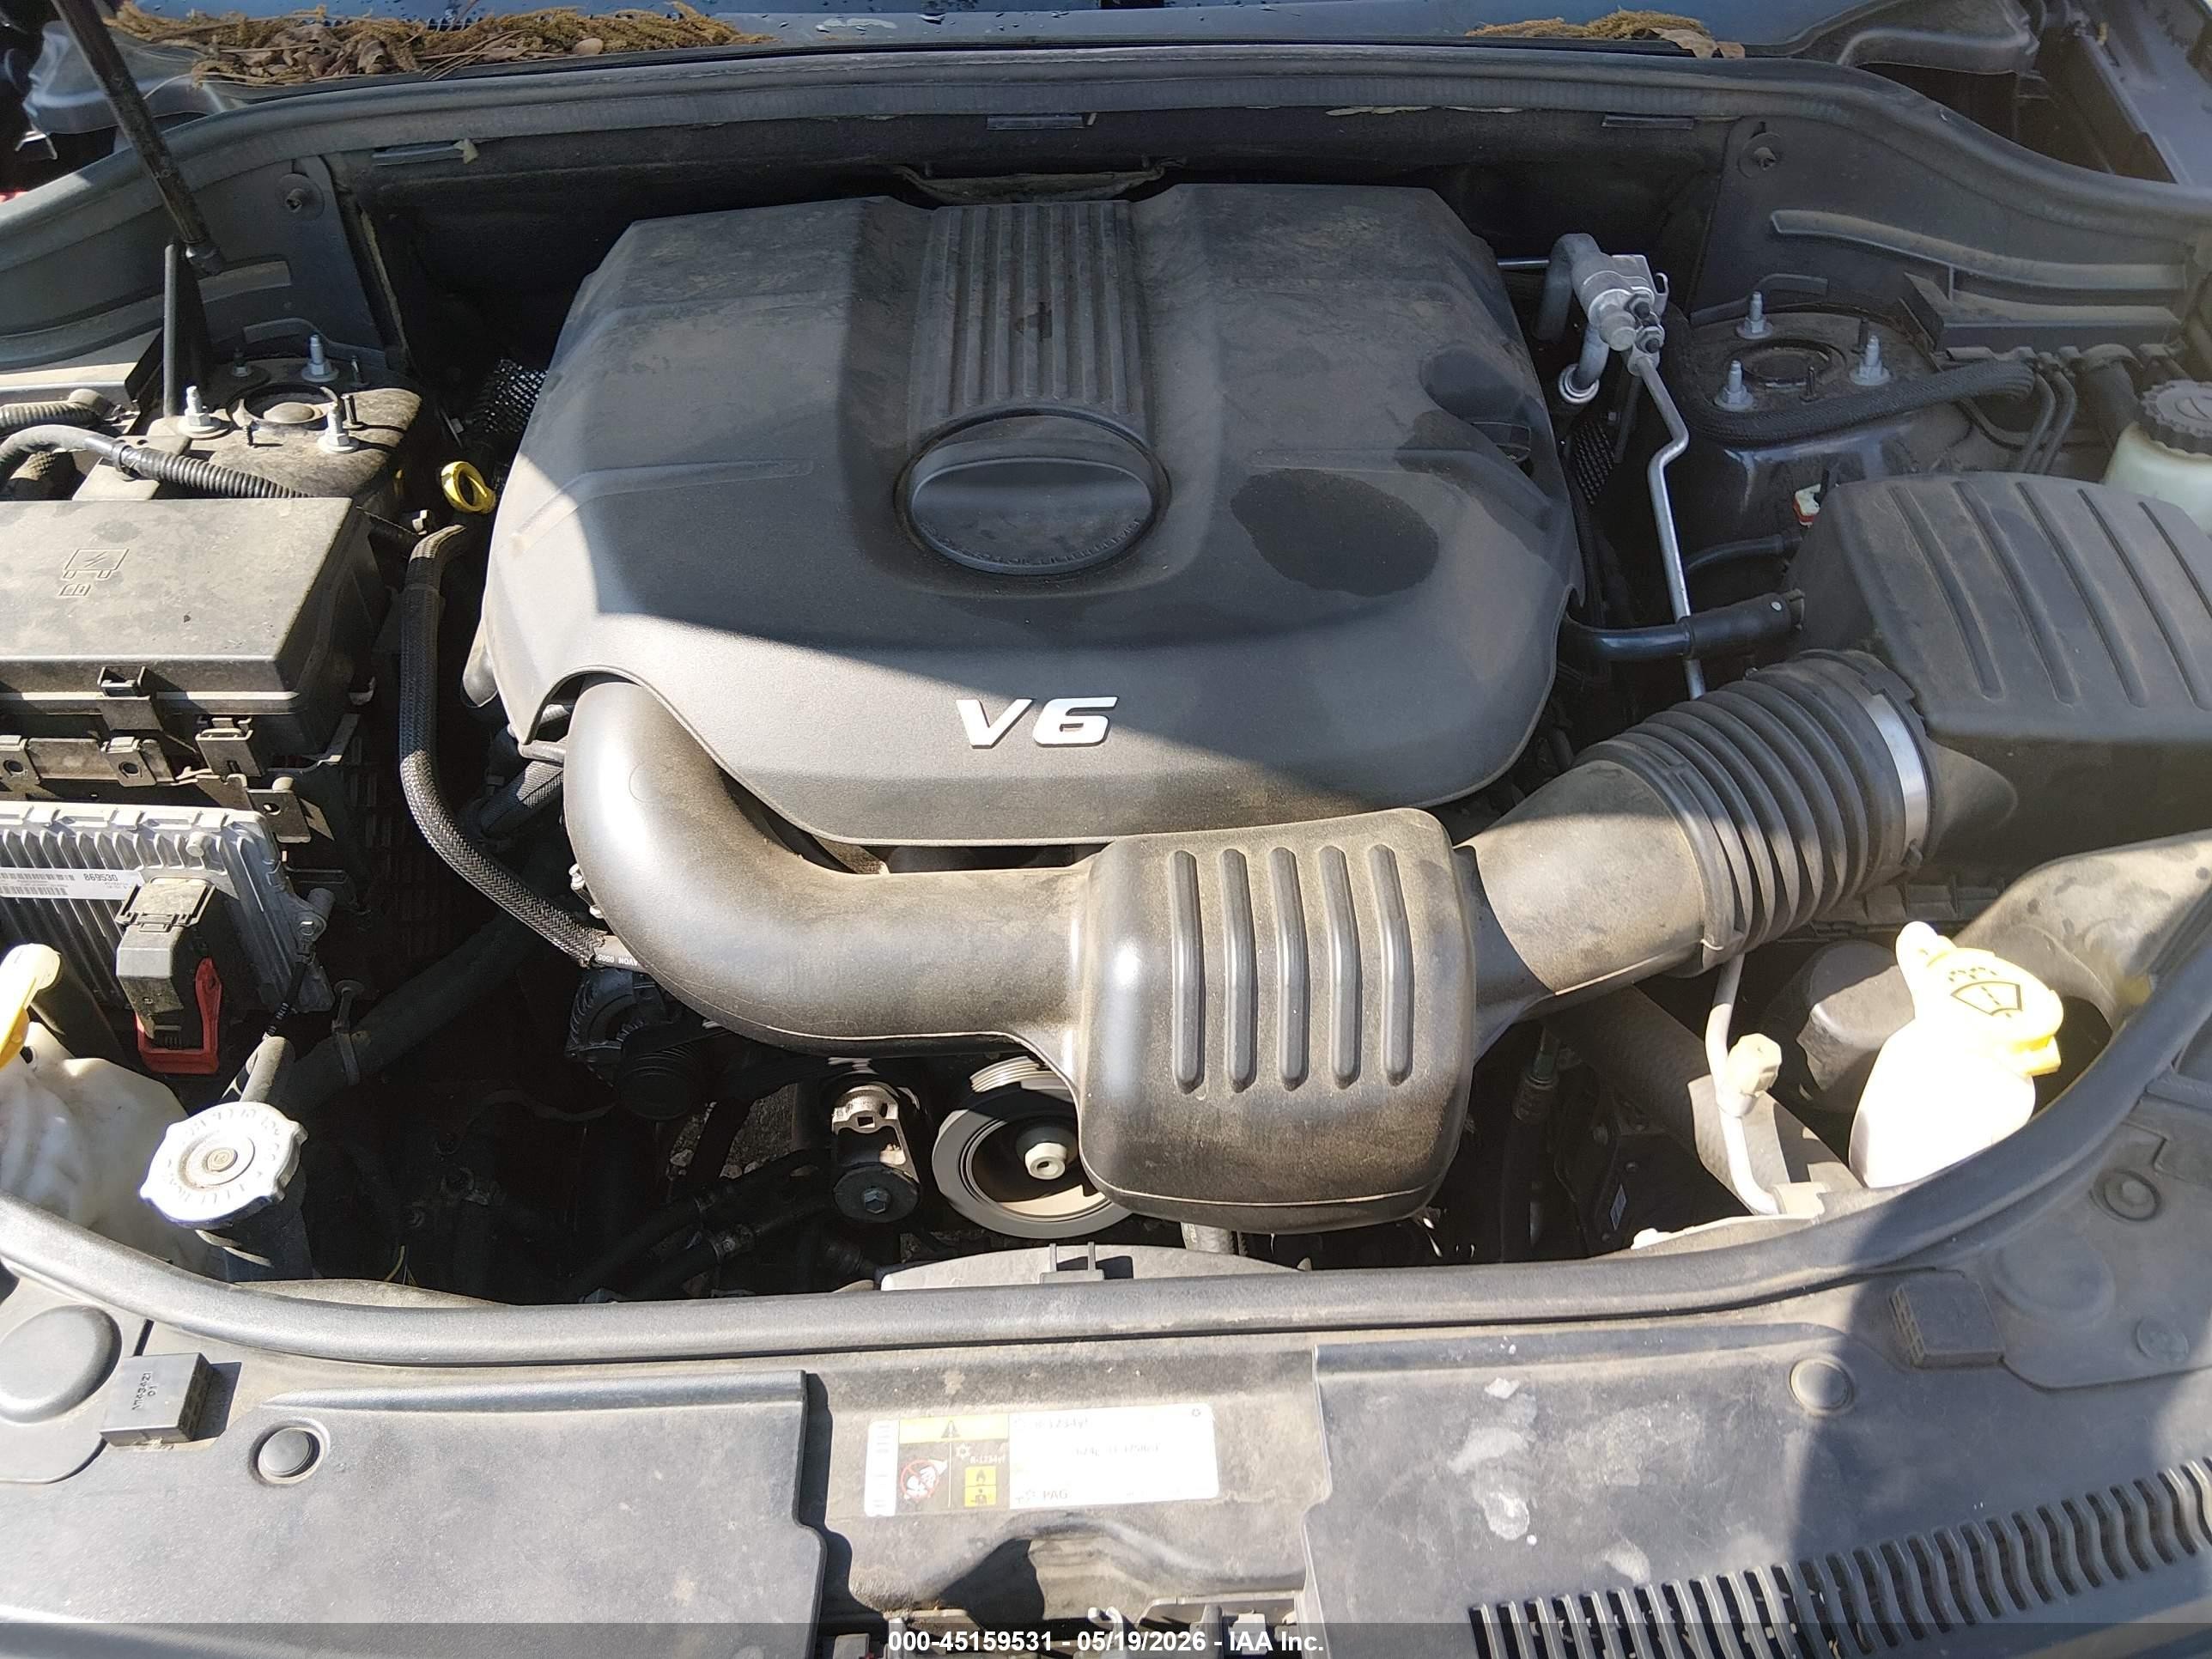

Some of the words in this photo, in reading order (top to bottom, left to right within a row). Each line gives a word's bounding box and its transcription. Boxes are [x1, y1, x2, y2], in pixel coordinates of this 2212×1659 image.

[956, 696, 1119, 749] V6
[83, 872, 118, 882] 869530
[1042, 1489, 1068, 1500] PAG
